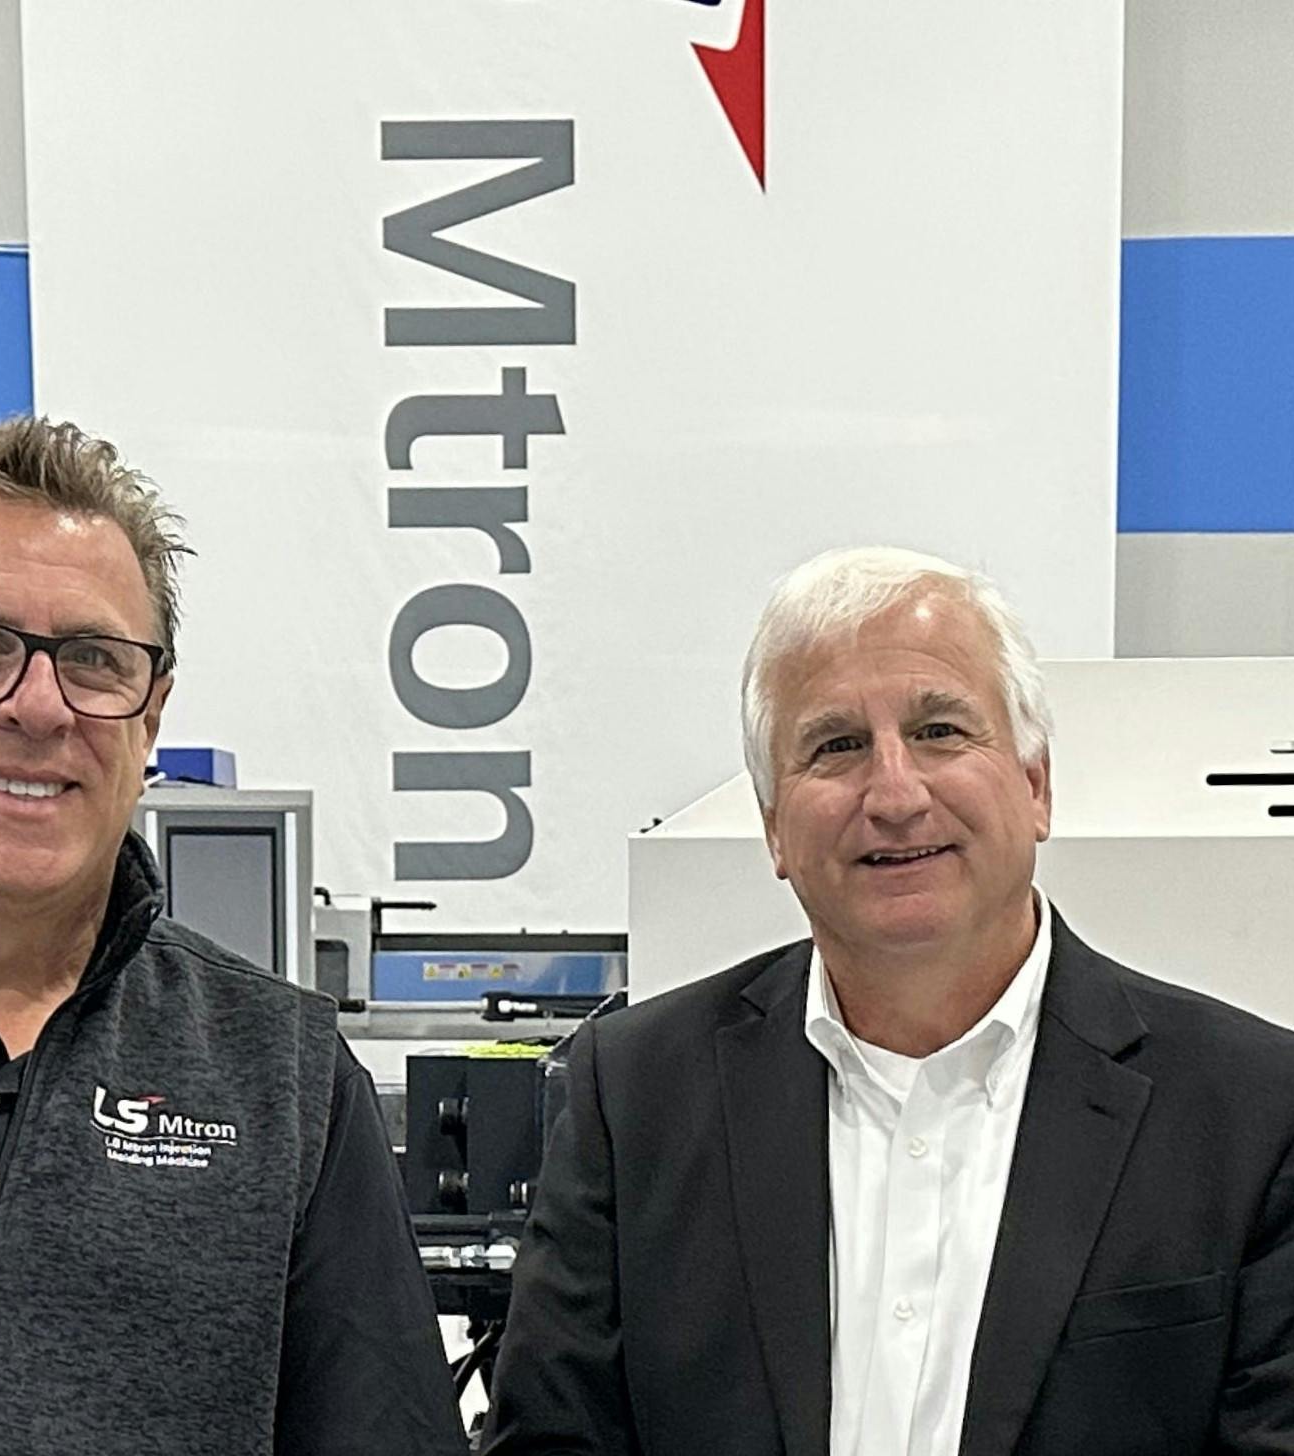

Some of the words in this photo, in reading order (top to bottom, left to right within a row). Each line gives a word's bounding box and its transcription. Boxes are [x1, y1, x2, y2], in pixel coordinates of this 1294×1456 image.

[380, 119, 578, 882] Mtron
[93, 1086, 150, 1134] LS
[158, 1114, 237, 1139] Mtron
